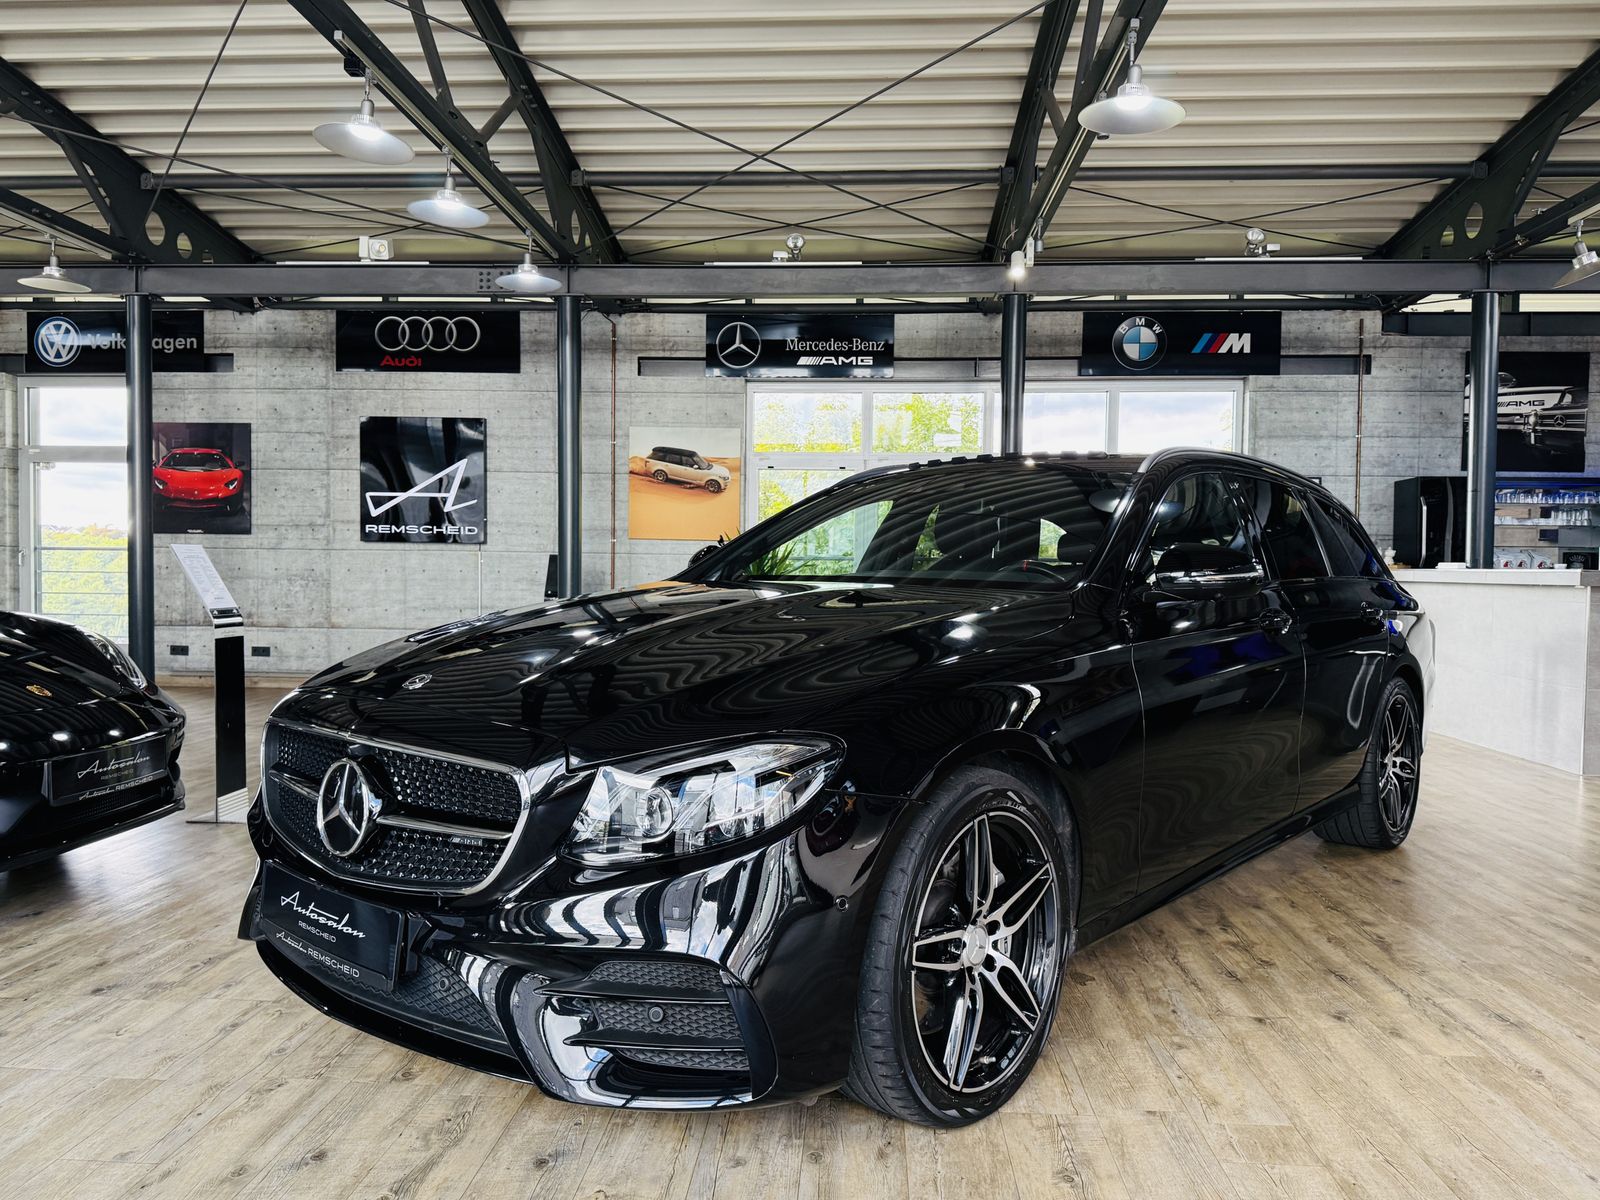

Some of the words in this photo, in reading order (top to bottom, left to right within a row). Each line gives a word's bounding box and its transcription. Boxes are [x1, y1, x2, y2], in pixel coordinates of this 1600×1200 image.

[1118, 317, 1163, 335] BMW
[87, 332, 197, 354] Volkagen
[786, 337, 885, 351] Mercedes-Benz
[380, 355, 422, 367] Audi
[819, 356, 874, 366] AMG
[1505, 399, 1545, 407] AMG
[365, 524, 478, 535] REMSCHEID
[77, 751, 150, 779] Autosalon
[280, 890, 366, 938] Autosalon
[298, 920, 337, 943] REMSCHEID
[307, 947, 360, 978] REMSCHEID
